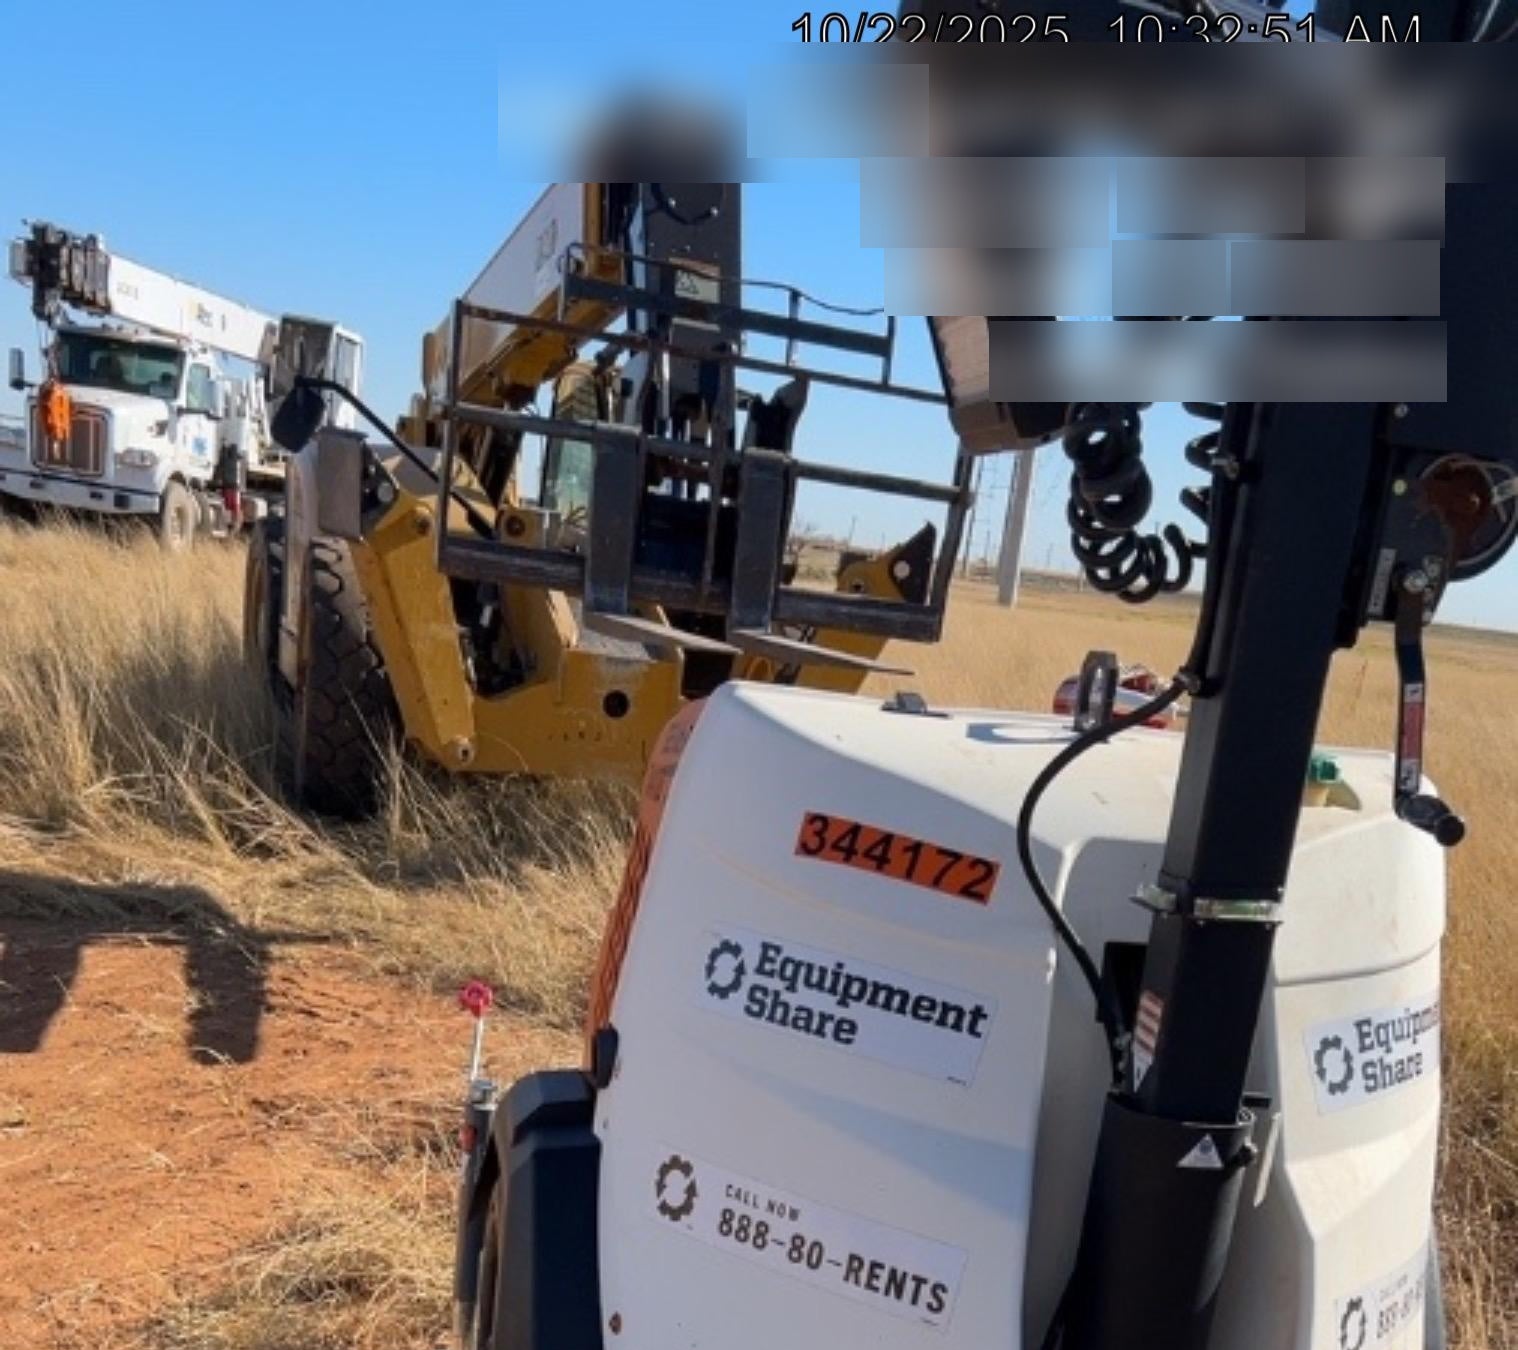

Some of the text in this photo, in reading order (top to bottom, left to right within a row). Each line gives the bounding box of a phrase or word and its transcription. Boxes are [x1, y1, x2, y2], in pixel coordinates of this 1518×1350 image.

[800, 814, 996, 901] 344172
[744, 983, 859, 1045] Share
[754, 941, 988, 1039] Equipment
[1361, 1052, 1423, 1093] Share
[725, 1183, 801, 1221] CALL NOW
[718, 1208, 949, 1314] 888-80-RENTS
